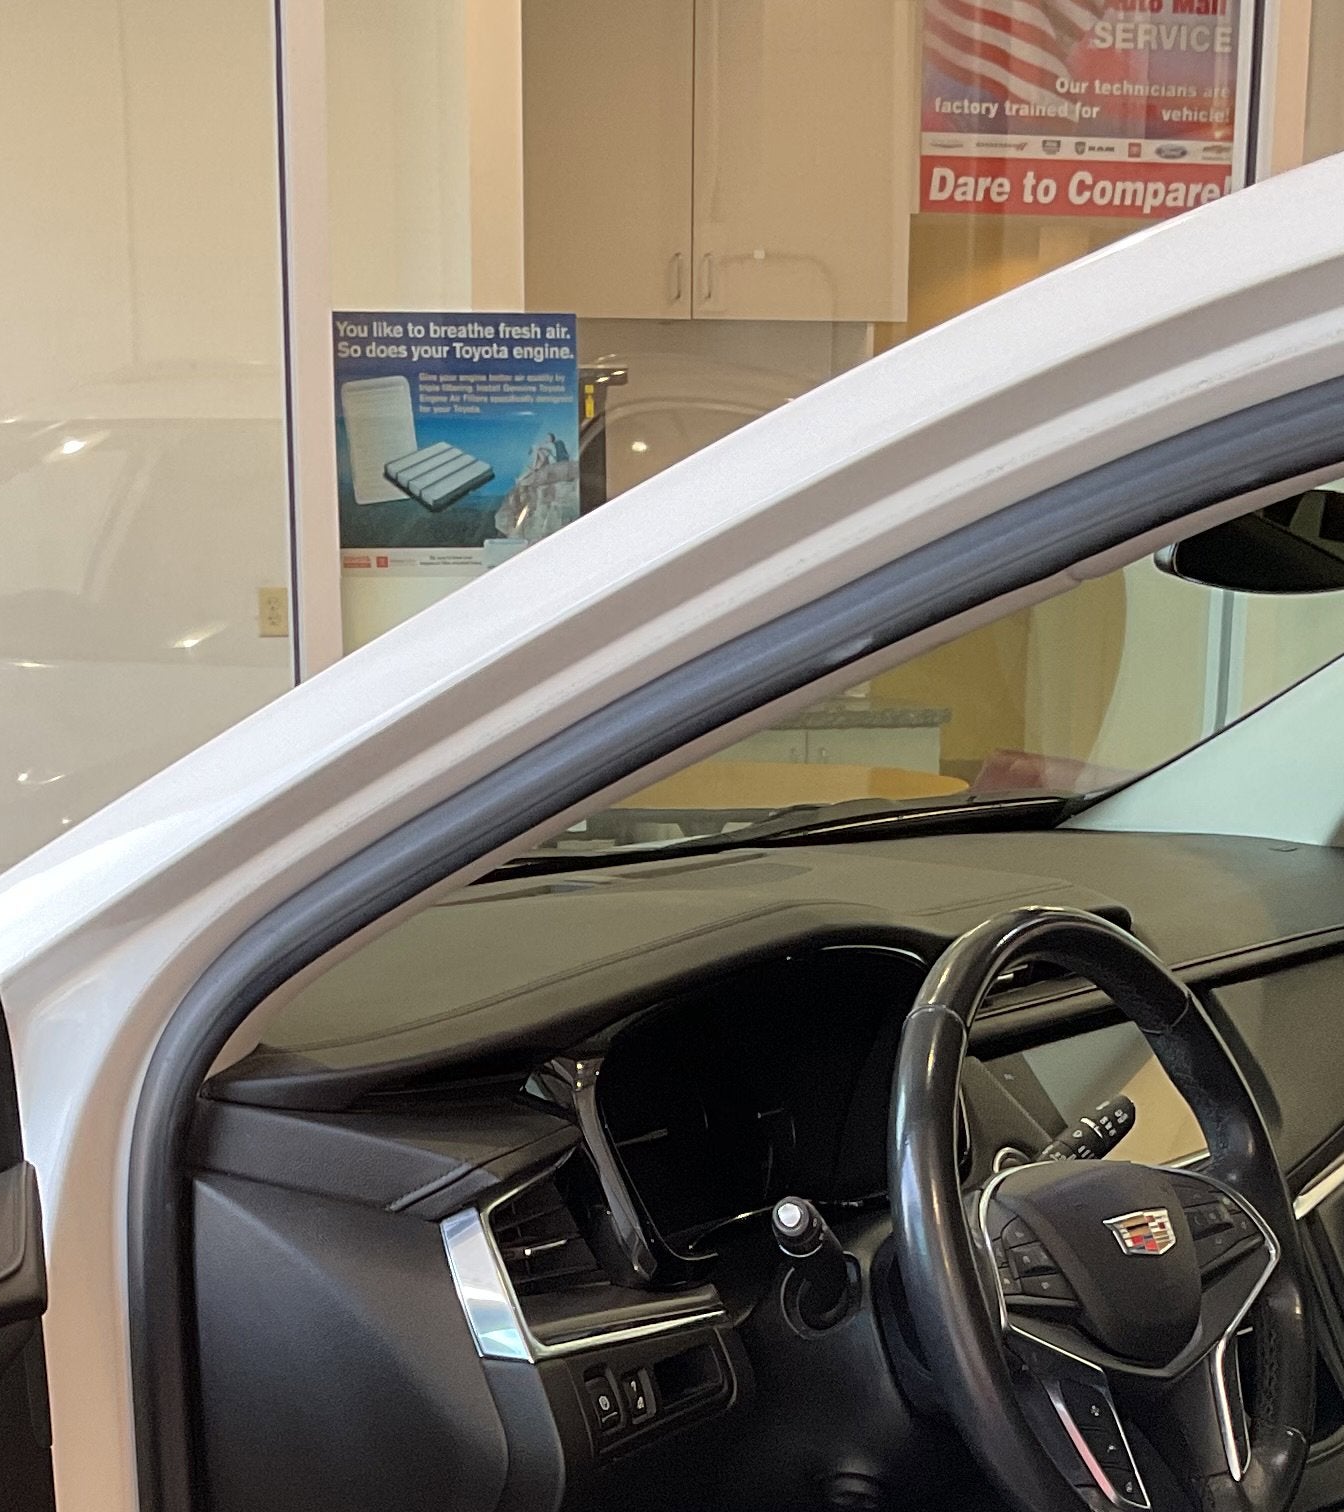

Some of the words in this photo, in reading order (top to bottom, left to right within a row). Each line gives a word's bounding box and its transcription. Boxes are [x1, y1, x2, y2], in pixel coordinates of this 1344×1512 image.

[1093, 22, 1233, 53] SERVICE
[1055, 78, 1088, 94] Our
[1094, 80, 1197, 98] technicians
[1202, 86, 1230, 99] are
[935, 97, 998, 119] factory
[1005, 99, 1068, 118] trained
[1075, 101, 1100, 119] for
[929, 167, 1011, 202] Dare
[1023, 172, 1056, 203] to
[1068, 170, 1232, 214] Compare!
[335, 321, 368, 338] You
[373, 322, 403, 338] like
[408, 322, 424, 338] to
[430, 322, 495, 339] breathe
[499, 323, 541, 339] fresh
[546, 323, 571, 339] air.
[337, 342, 361, 358] So
[366, 342, 407, 358] does
[411, 345, 449, 362] your
[453, 343, 508, 363] Toyota
[513, 345, 574, 363] engine.
